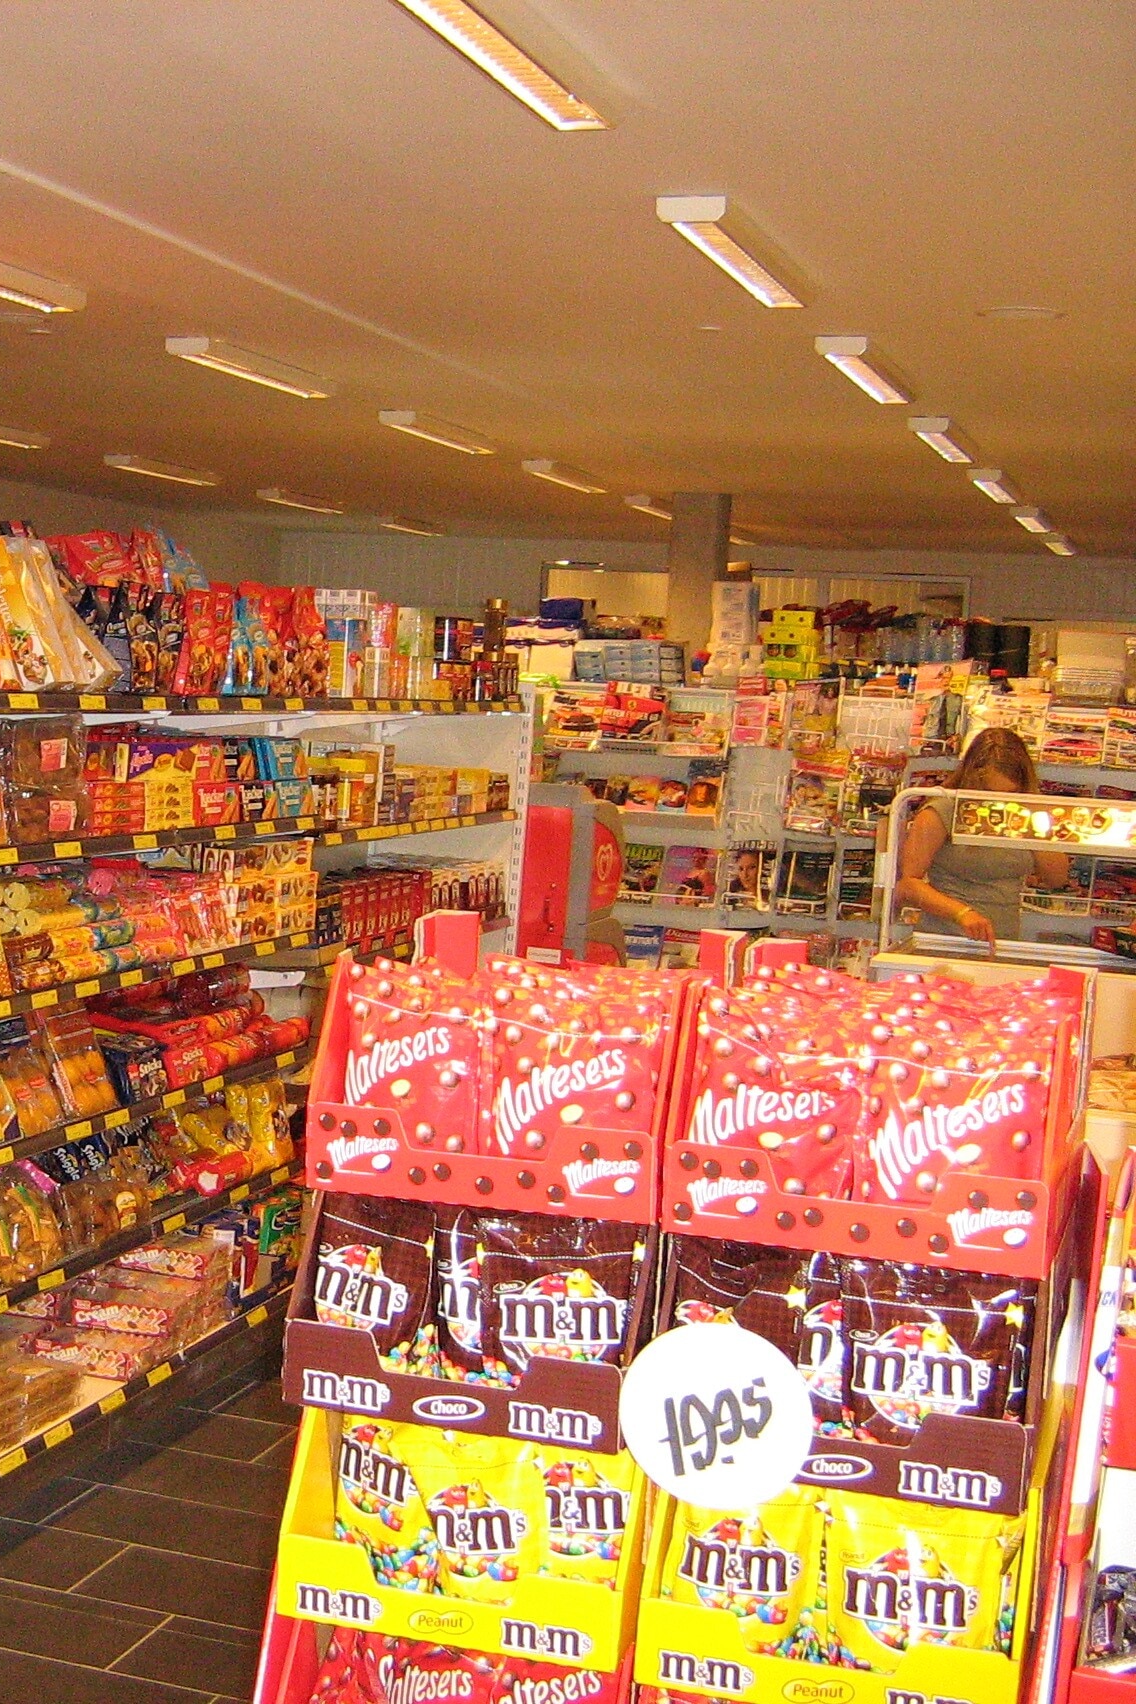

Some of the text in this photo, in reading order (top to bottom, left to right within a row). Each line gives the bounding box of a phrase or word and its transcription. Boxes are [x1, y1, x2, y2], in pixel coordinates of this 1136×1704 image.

[344, 1025, 451, 1106] Maltesers
[493, 1048, 627, 1156] Maltesers
[688, 1083, 836, 1146] Maltesers
[327, 1136, 399, 1167] Maltesers
[869, 1083, 1026, 1200] Maltesers
[563, 1157, 641, 1196] Maltesers
[686, 1176, 767, 1211] Maltesers
[947, 1207, 1033, 1246] Maltesers
[74, 1306, 120, 1323] Cream
[430, 1398, 468, 1415] Choco
[811, 1458, 853, 1476] Choco
[417, 1613, 464, 1629] Peanut
[498, 1669, 602, 1704] altesers
[793, 1684, 845, 1699] Peanut
